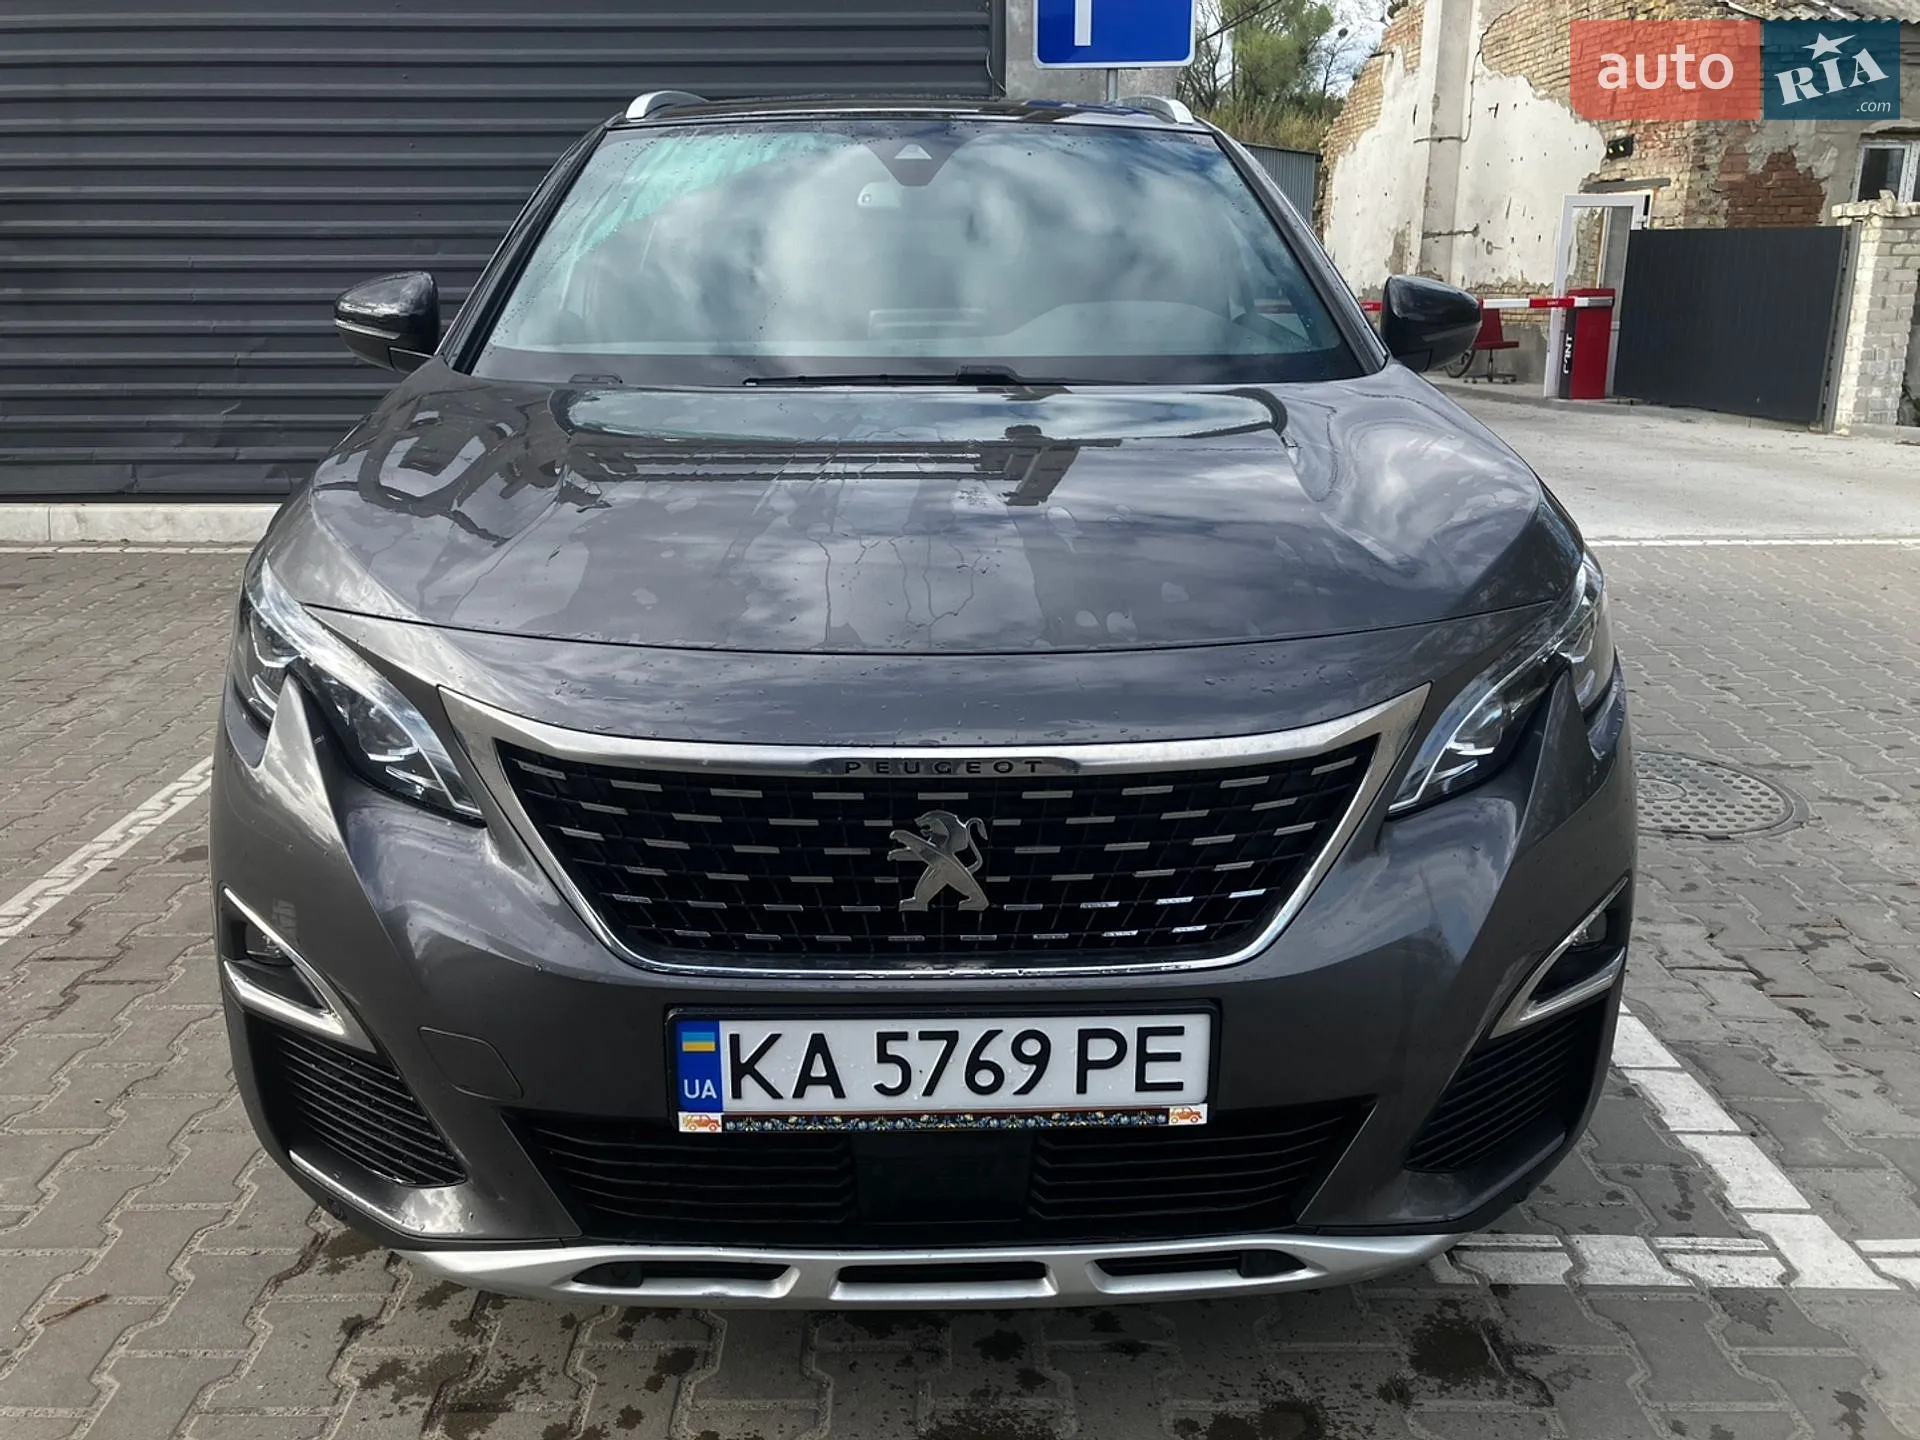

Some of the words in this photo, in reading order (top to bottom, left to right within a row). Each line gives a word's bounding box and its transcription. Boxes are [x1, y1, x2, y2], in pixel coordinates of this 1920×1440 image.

[844, 761, 1043, 774] PEUGEOT
[729, 1033, 847, 1099] KA
[873, 1030, 1053, 1097] 5769
[1075, 1026, 1185, 1094] PE
[683, 1079, 717, 1099] UA
